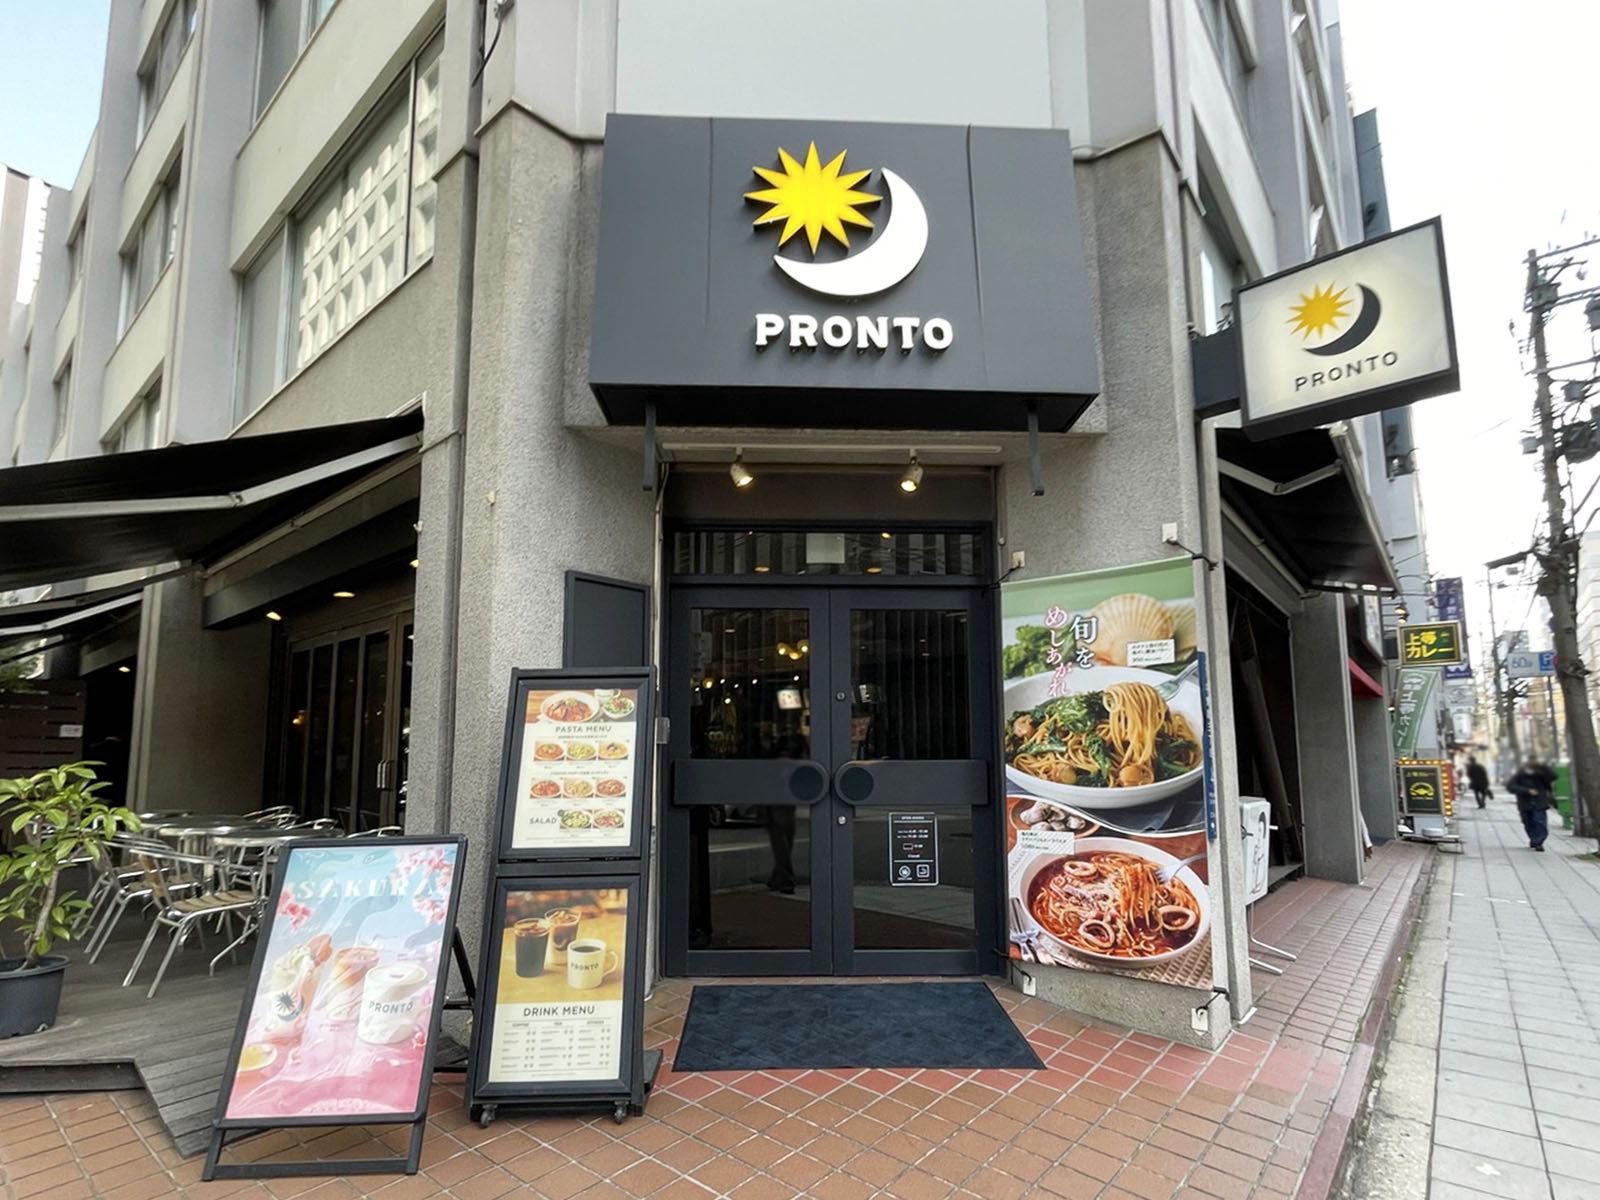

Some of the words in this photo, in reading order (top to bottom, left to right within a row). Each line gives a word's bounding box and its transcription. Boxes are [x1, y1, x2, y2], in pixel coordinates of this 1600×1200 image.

[755, 313, 954, 350] PRONTO
[1294, 351, 1398, 392] PRONTO
[1044, 604, 1072, 697] めしあがれ
[1070, 615, 1099, 669] 旬を
[1406, 644, 1454, 658] カレー
[555, 725, 583, 733] PASTA
[585, 725, 612, 733] MENU
[529, 816, 557, 825] SALAD
[297, 878, 435, 899] SAKURA
[369, 1000, 414, 1014] PRONTO
[523, 1006, 559, 1017] DRINK
[562, 1005, 596, 1016] MENU
